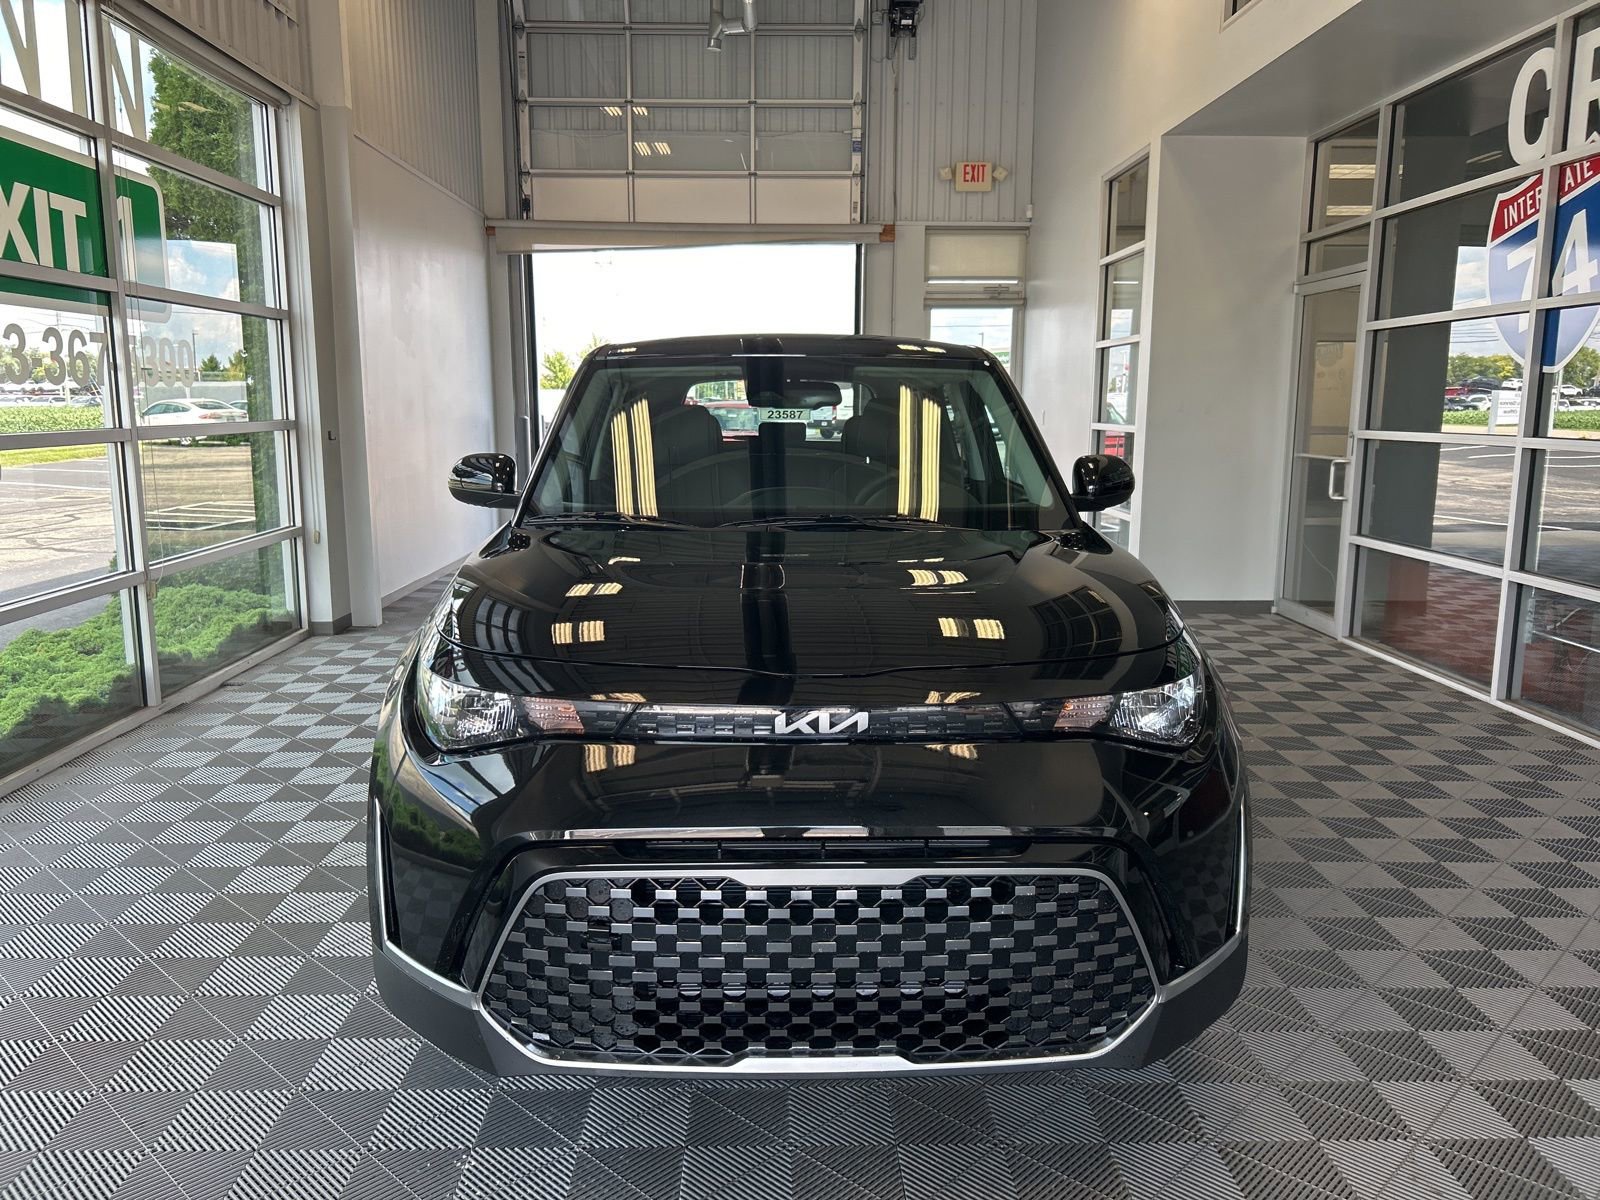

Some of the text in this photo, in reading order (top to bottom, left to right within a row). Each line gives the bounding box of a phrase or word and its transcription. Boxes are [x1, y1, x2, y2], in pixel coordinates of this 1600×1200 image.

[963, 164, 986, 183] EXIT
[1504, 160, 1594, 230] INTERATE
[117, 195, 137, 282] 1
[1507, 209, 1598, 334] 74
[767, 410, 803, 419] 23587
[775, 711, 869, 734] KIA
